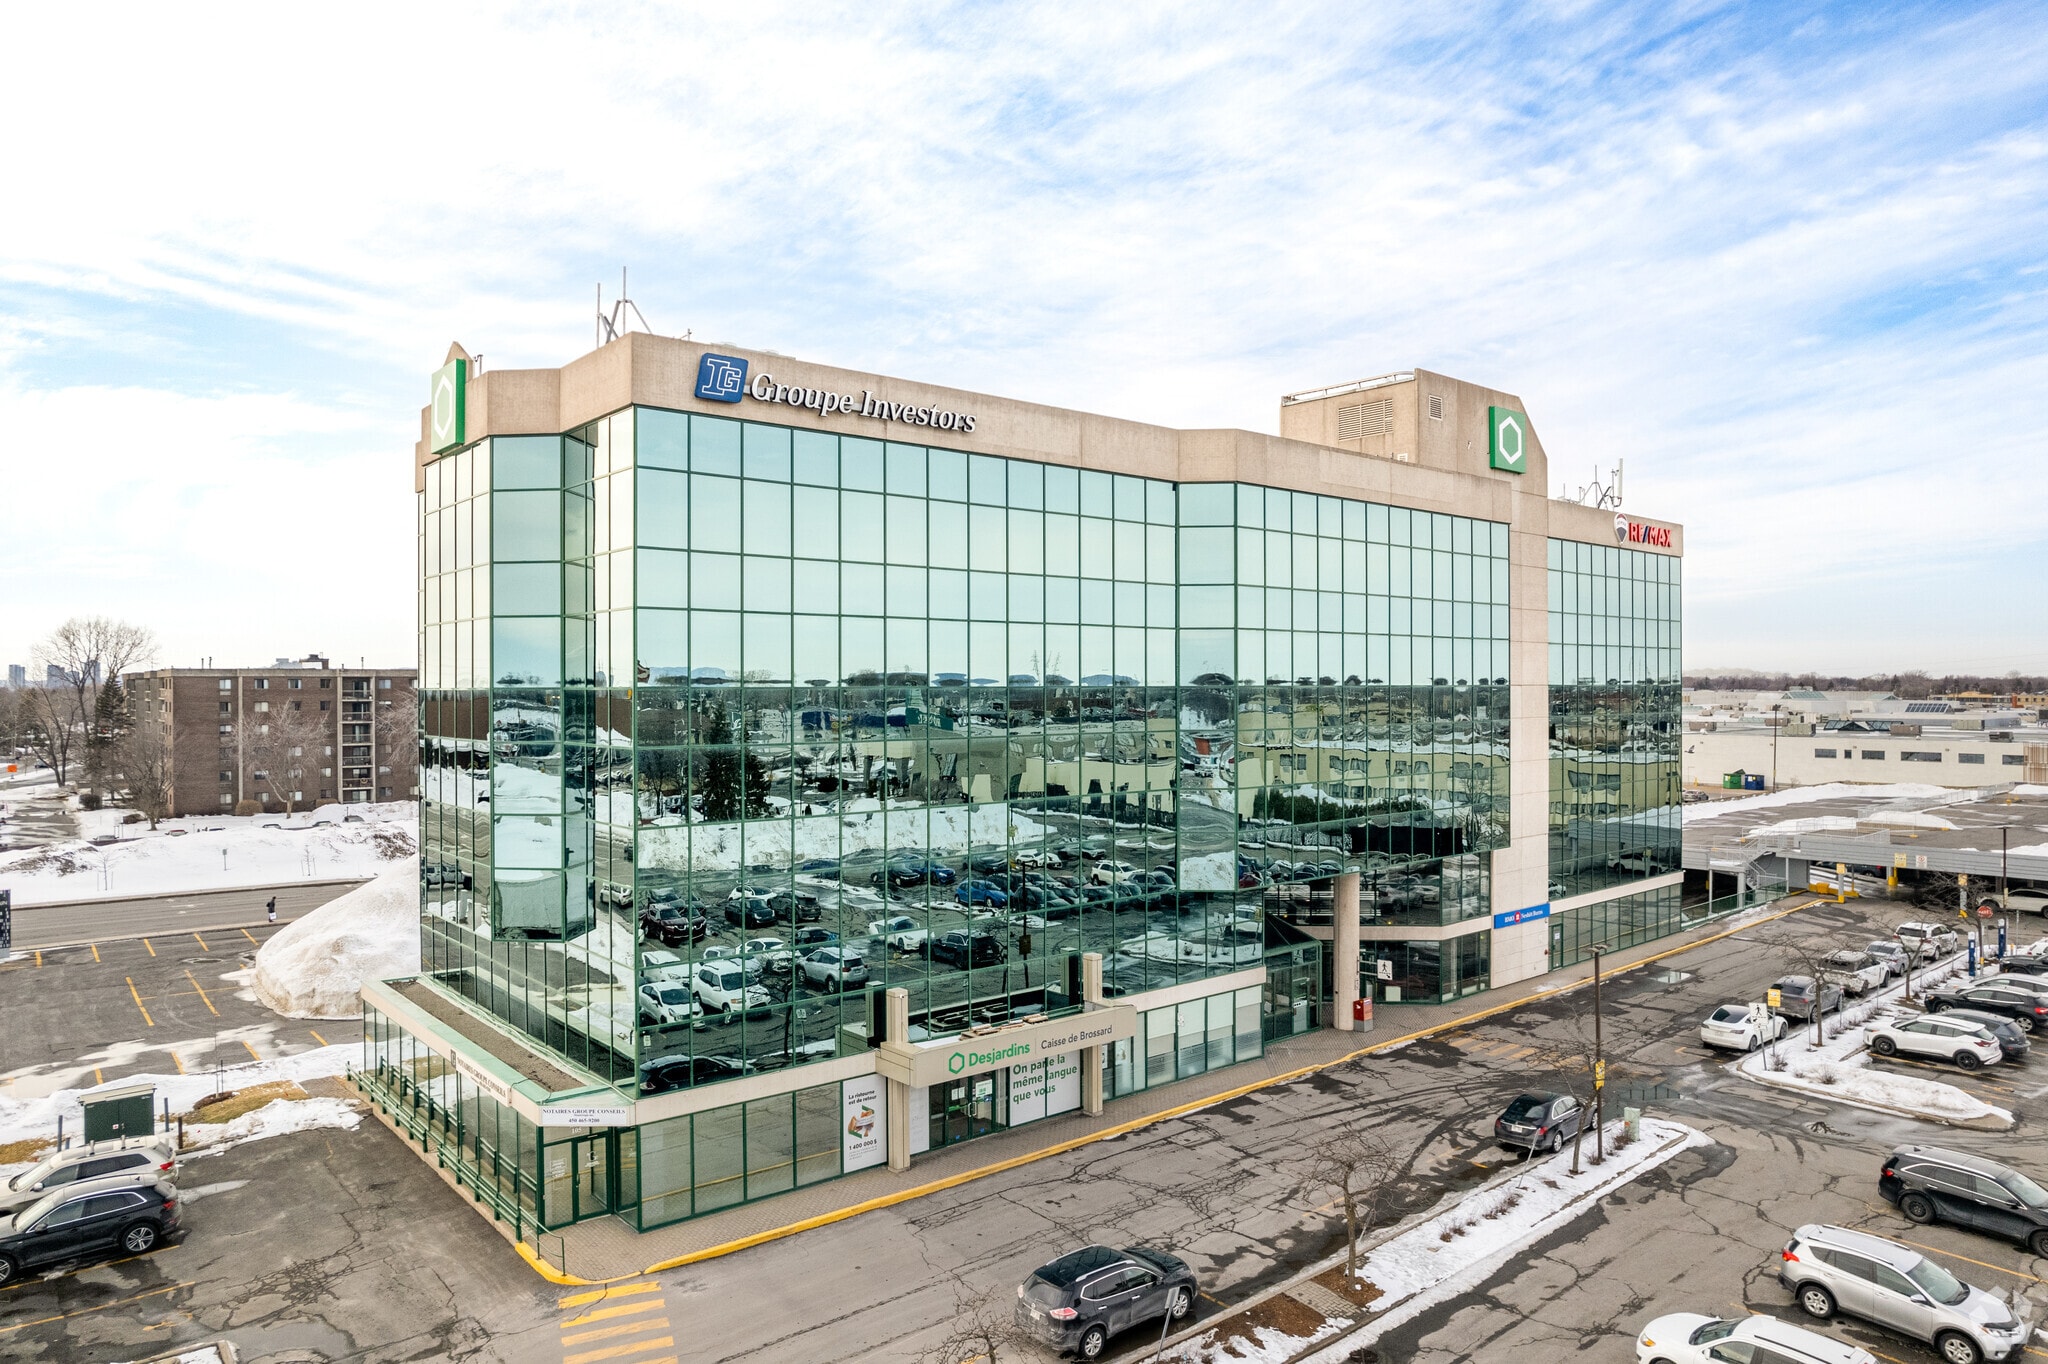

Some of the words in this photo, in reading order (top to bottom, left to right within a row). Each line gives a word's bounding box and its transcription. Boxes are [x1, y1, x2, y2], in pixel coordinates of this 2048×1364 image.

[751, 373, 854, 417] Groupe
[860, 390, 977, 433] Investors
[1628, 522, 1673, 547] RE/MAX
[968, 1042, 1031, 1067] Desjardins
[1041, 1038, 1066, 1050] Caisse
[1067, 1033, 1078, 1043] de
[1079, 1024, 1113, 1041] Brossard
[1013, 1064, 1028, 1075] On
[1030, 1056, 1055, 1073] parle
[1056, 1054, 1065, 1065] la
[1013, 1074, 1043, 1089] même
[855, 1090, 875, 1098] ristourne
[1013, 1091, 1031, 1104] que
[1034, 1084, 1056, 1096] vous
[852, 1142, 863, 1150] 400
[863, 1139, 874, 1147] 000
